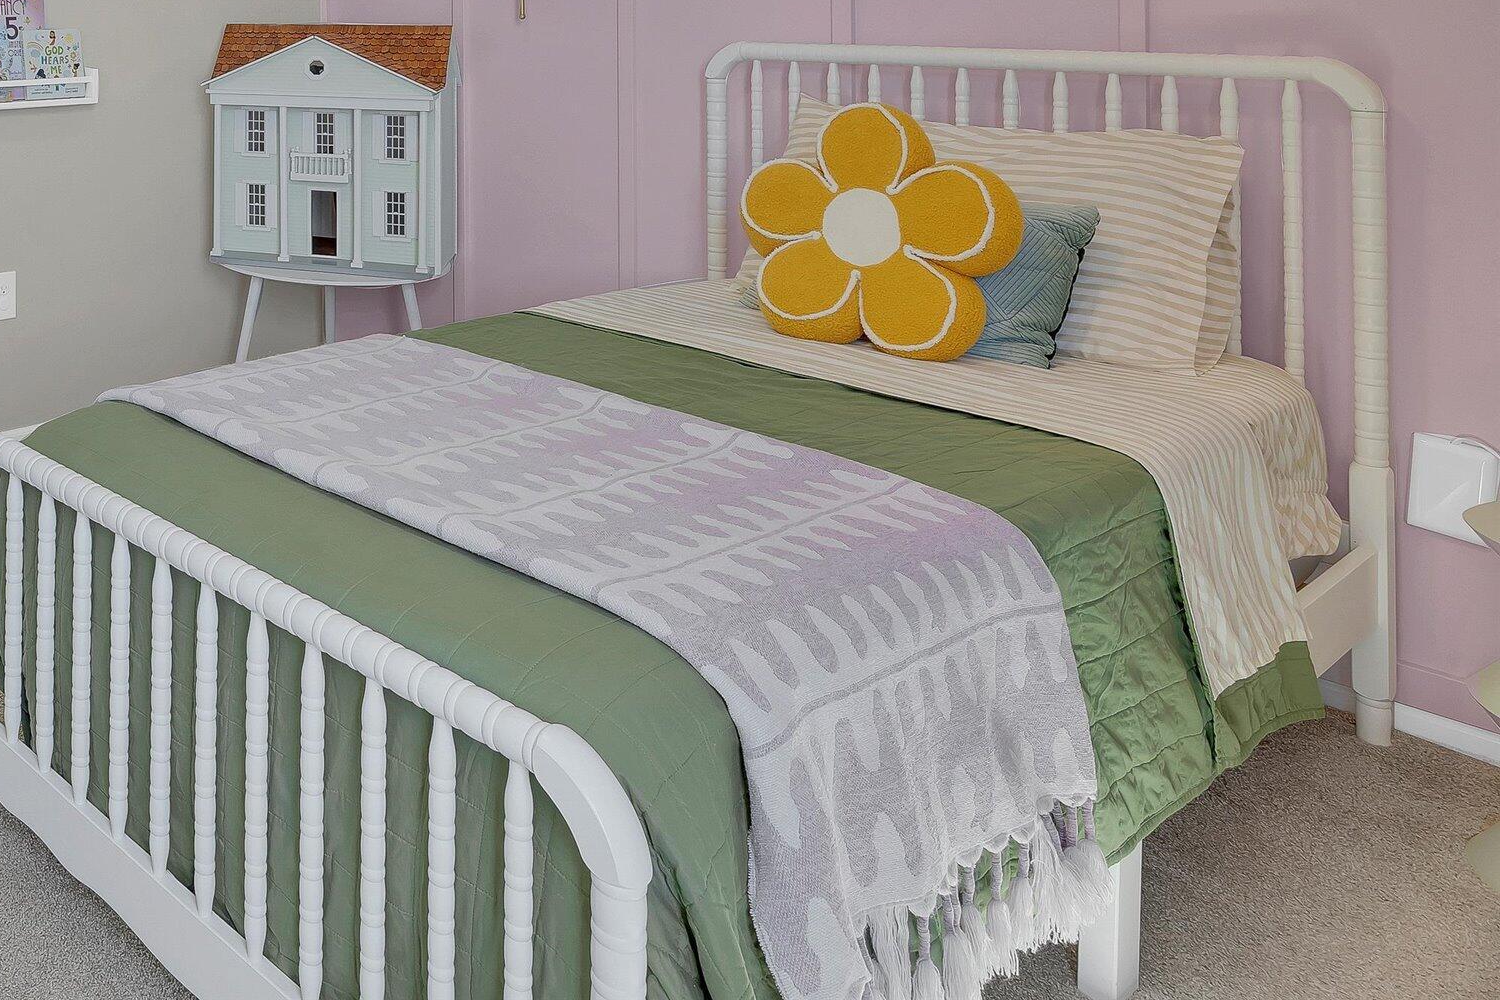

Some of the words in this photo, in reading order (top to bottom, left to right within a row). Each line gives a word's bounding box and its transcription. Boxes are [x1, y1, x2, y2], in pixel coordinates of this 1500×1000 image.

[45, 45, 64, 56] GOD
[41, 55, 69, 65] HEARS
[50, 66, 62, 75] ME
